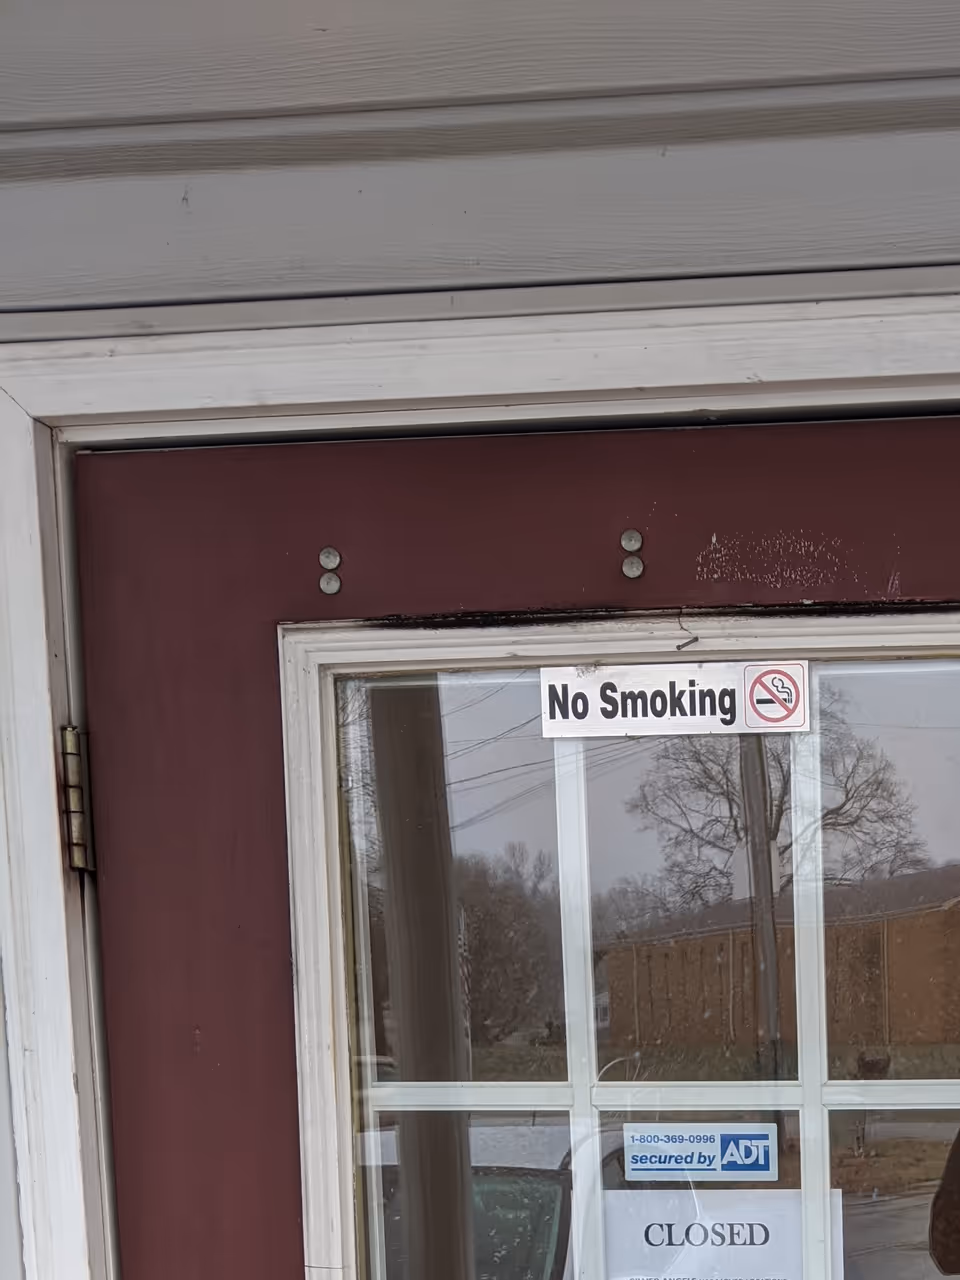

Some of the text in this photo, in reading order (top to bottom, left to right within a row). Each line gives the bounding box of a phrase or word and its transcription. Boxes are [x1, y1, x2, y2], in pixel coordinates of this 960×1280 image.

[548, 679, 736, 726] No Smoking
[630, 1135, 716, 1144] 1-800-369-0996
[721, 1139, 769, 1165] ADT
[631, 1152, 716, 1167] secured by
[644, 1222, 770, 1247] CLOSED
